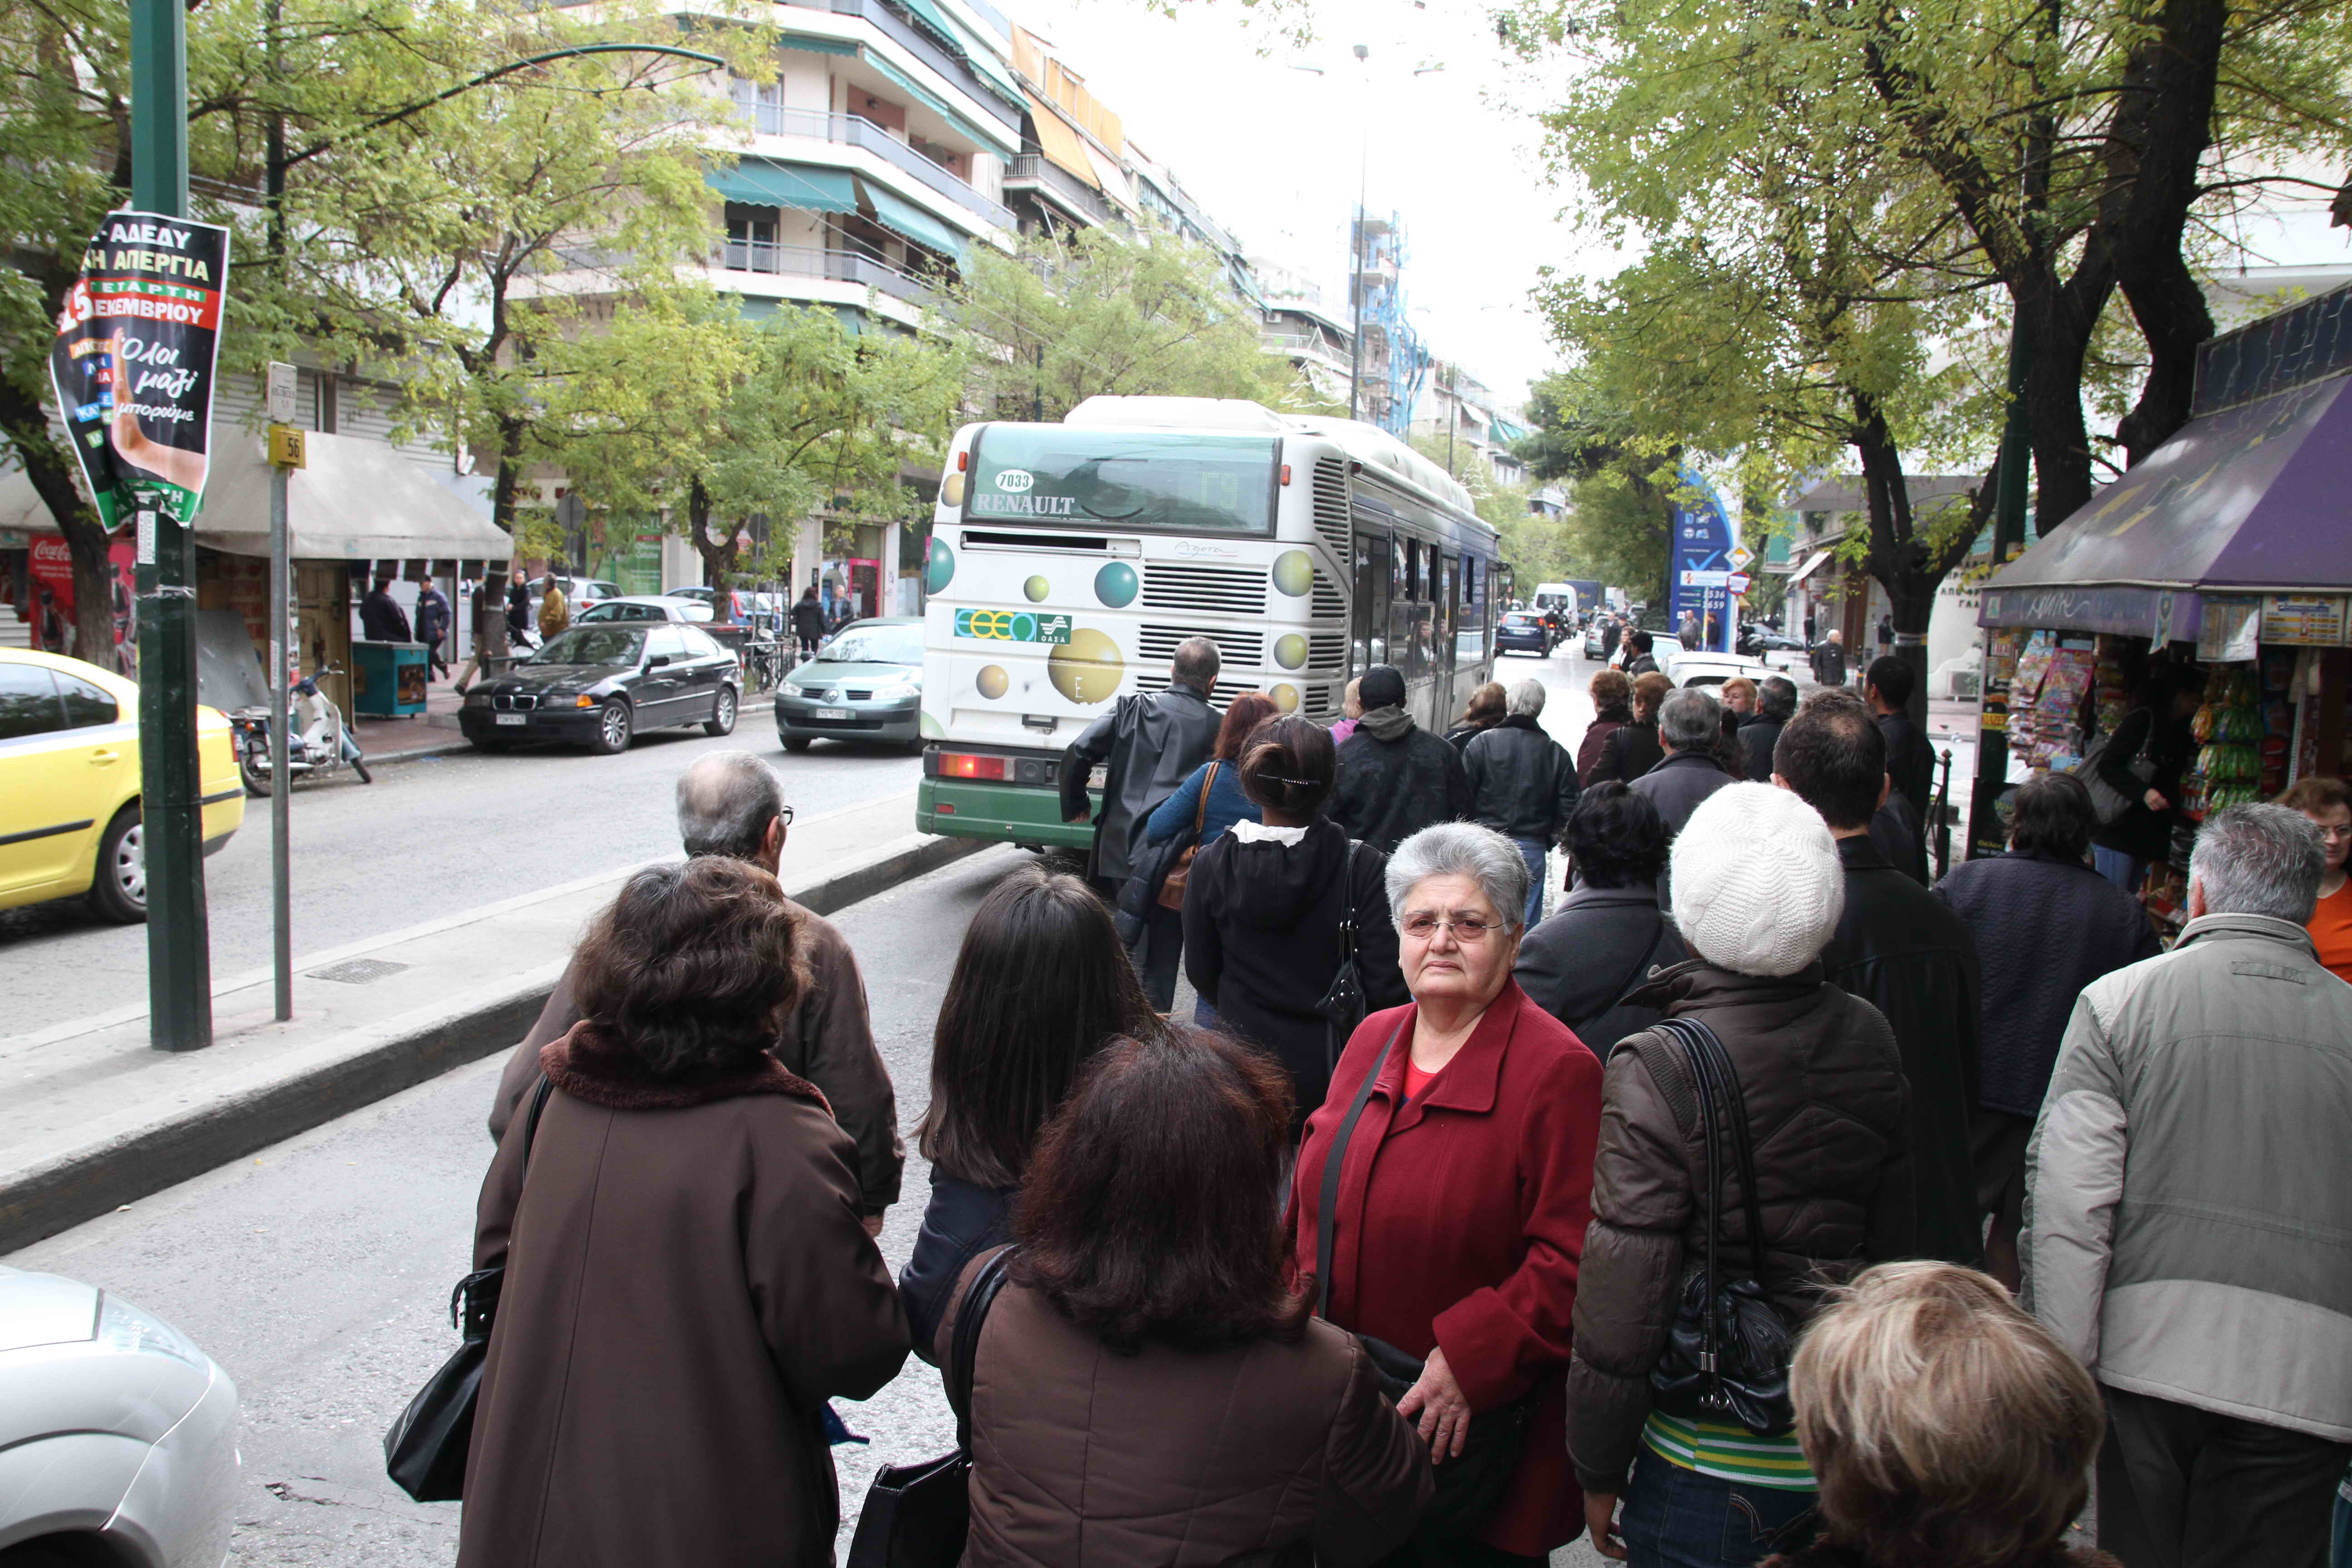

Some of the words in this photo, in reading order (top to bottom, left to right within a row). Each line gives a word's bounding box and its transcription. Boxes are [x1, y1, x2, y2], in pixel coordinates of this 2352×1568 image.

[113, 250, 210, 283] ΑΠΕΡΓΙΑ
[93, 298, 204, 324] ΕΚΕΜΒΡΙΟΥ
[120, 337, 180, 366] Όλοι
[135, 368, 199, 399] μαζί
[118, 402, 195, 424] μπορούμε
[1000, 474, 1030, 488] 7033
[976, 494, 1075, 515] RENAULT
[1175, 541, 1238, 559] Agora
